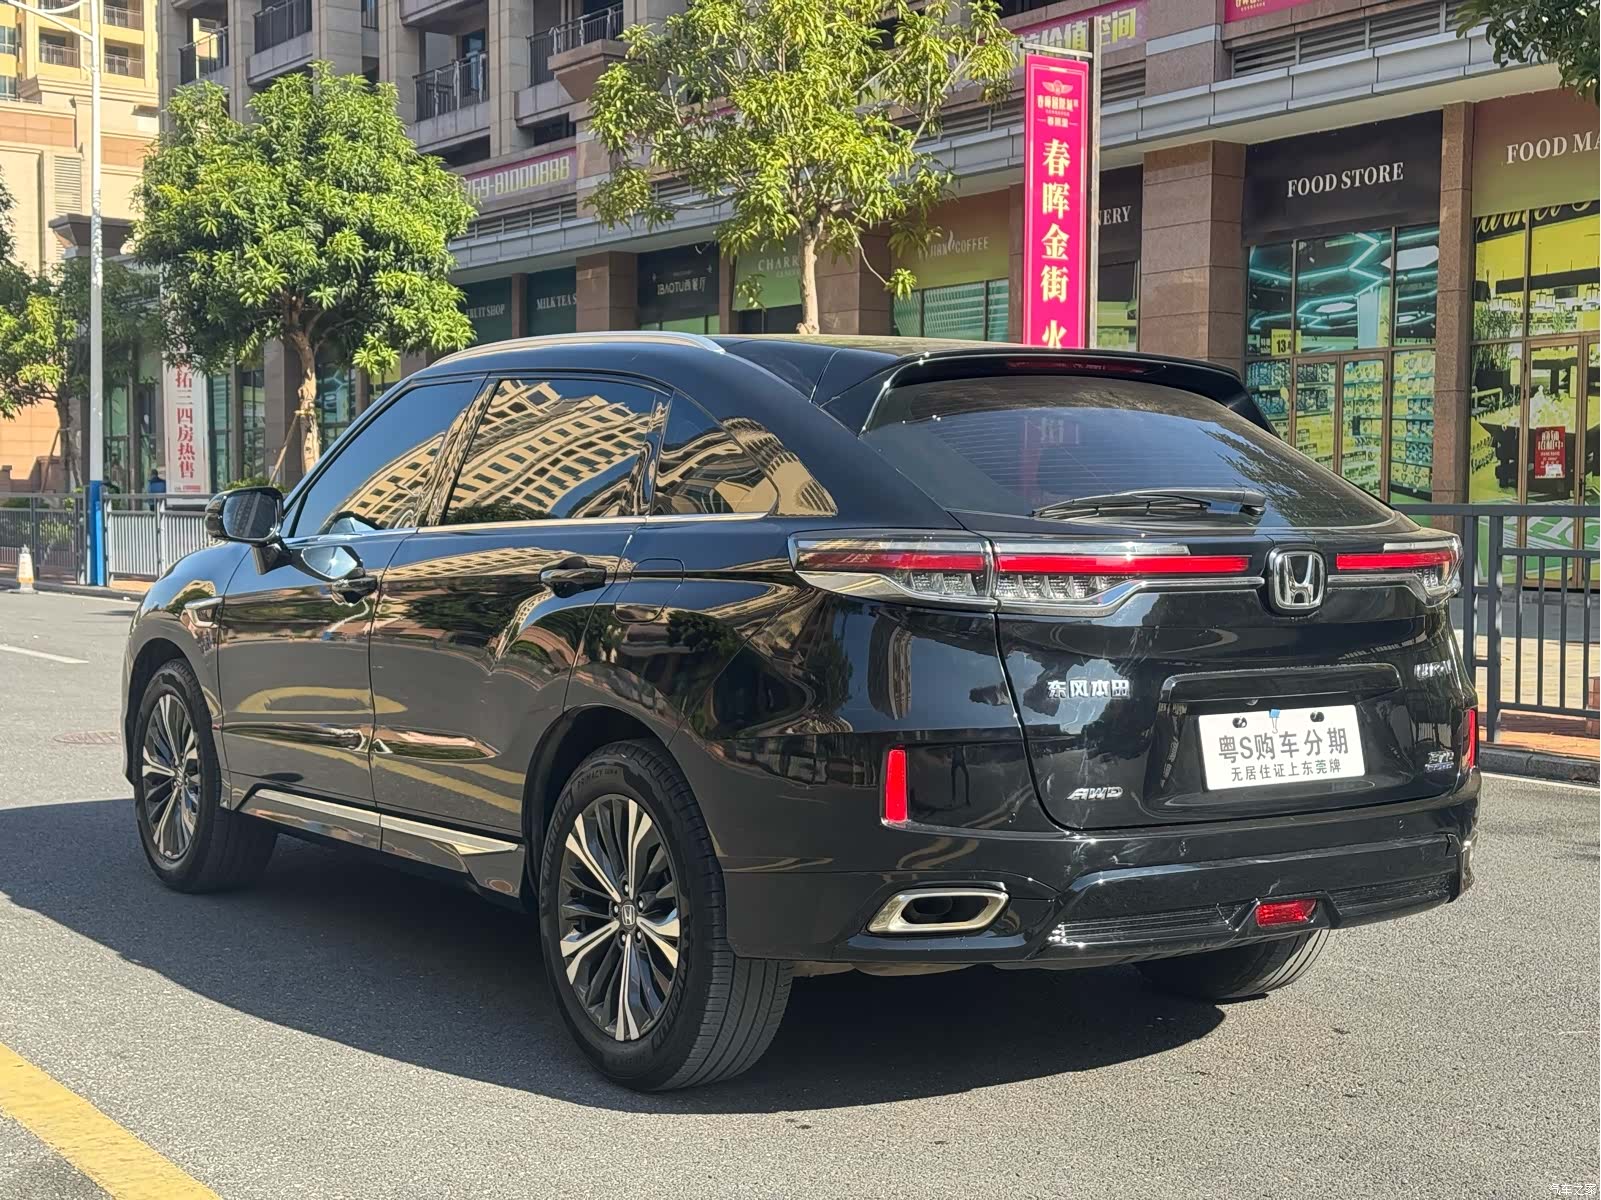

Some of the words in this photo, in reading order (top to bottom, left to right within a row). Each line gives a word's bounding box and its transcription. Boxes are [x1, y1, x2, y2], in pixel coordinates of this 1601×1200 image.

[1506, 136, 1568, 165] FOOD
[1287, 173, 1338, 198] FOOD
[1341, 162, 1404, 189] STORE
[955, 236, 989, 254] COFFEE
[486, 303, 506, 317] SHOP
[536, 296, 556, 310] MILK
[556, 294, 571, 308] TEA
[1047, 679, 1131, 699] 东风本田
[1218, 727, 1349, 764] 粤S购车分期
[1231, 758, 1342, 782] 无居住证上东莞牌
[1066, 786, 1124, 800] AWD
